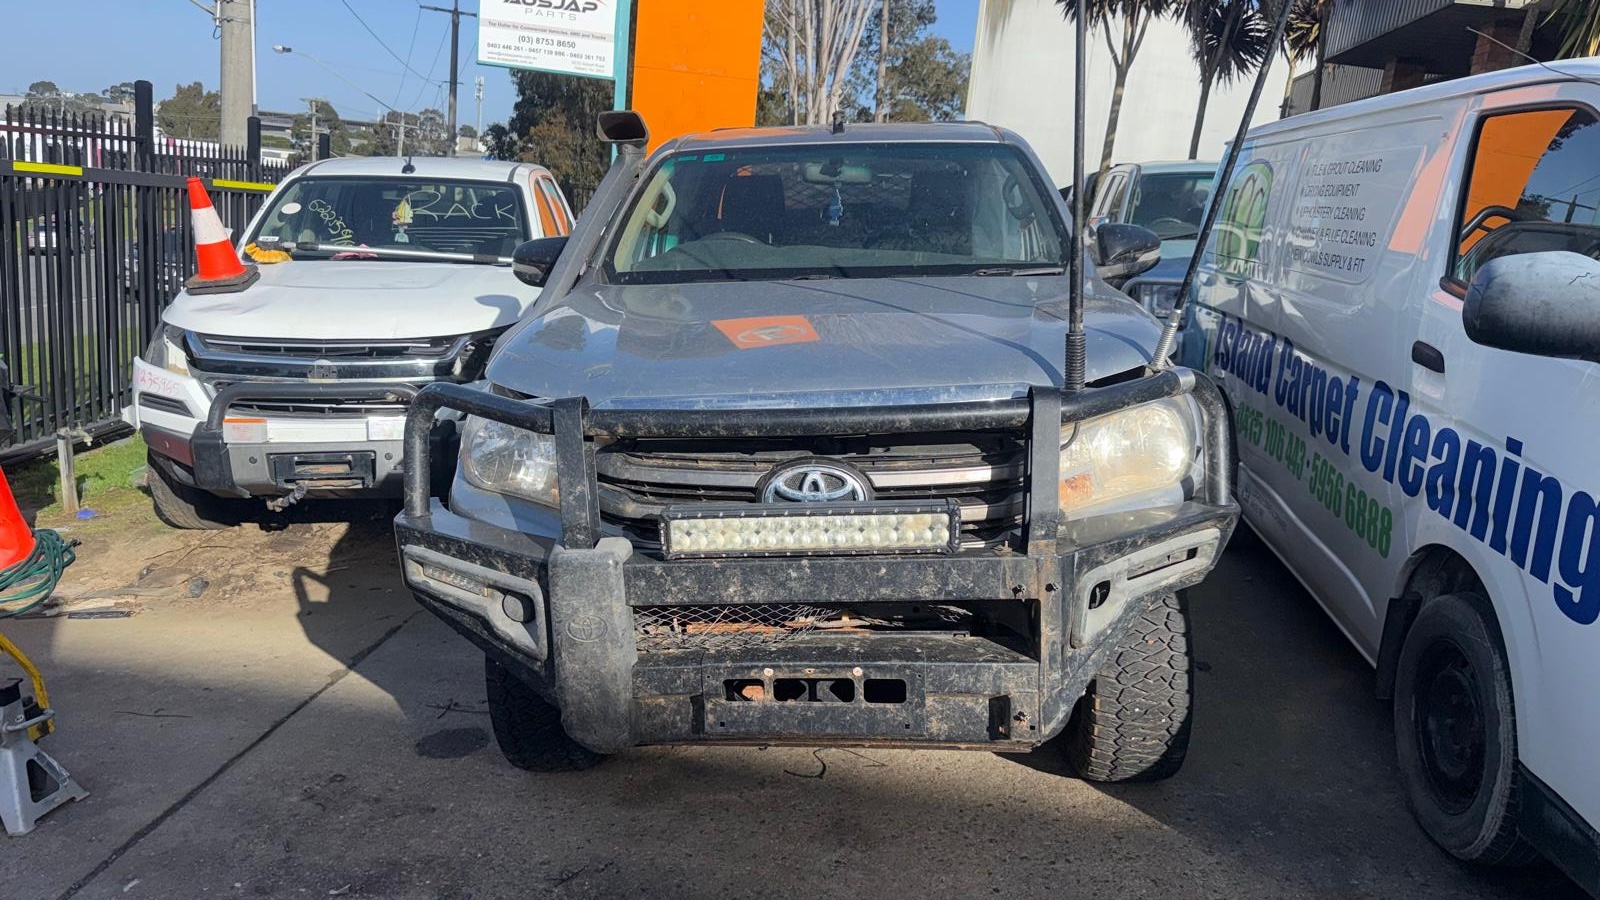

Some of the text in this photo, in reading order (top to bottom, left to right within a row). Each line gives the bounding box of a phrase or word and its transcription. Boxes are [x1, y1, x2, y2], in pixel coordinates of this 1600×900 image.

[524, 7, 577, 21] PARTS
[518, 34, 576, 49] (03) 8753 8650
[1347, 158, 1383, 174] CLEANING
[1324, 183, 1361, 197] EQUIPMENT
[1333, 206, 1367, 221] CLEANING
[1340, 229, 1377, 247] CLEANING
[1322, 252, 1348, 270] SUPPLY
[1352, 257, 1366, 273] FIT
[1214, 312, 1277, 397] Island
[1275, 336, 1360, 456] Carpet
[1361, 380, 1600, 626] Cleaning
[1235, 401, 1264, 447] 0415
[1263, 417, 1286, 463] 106
[1285, 431, 1307, 481] 443
[1309, 452, 1345, 519] 5956
[1345, 481, 1393, 560] 6888
